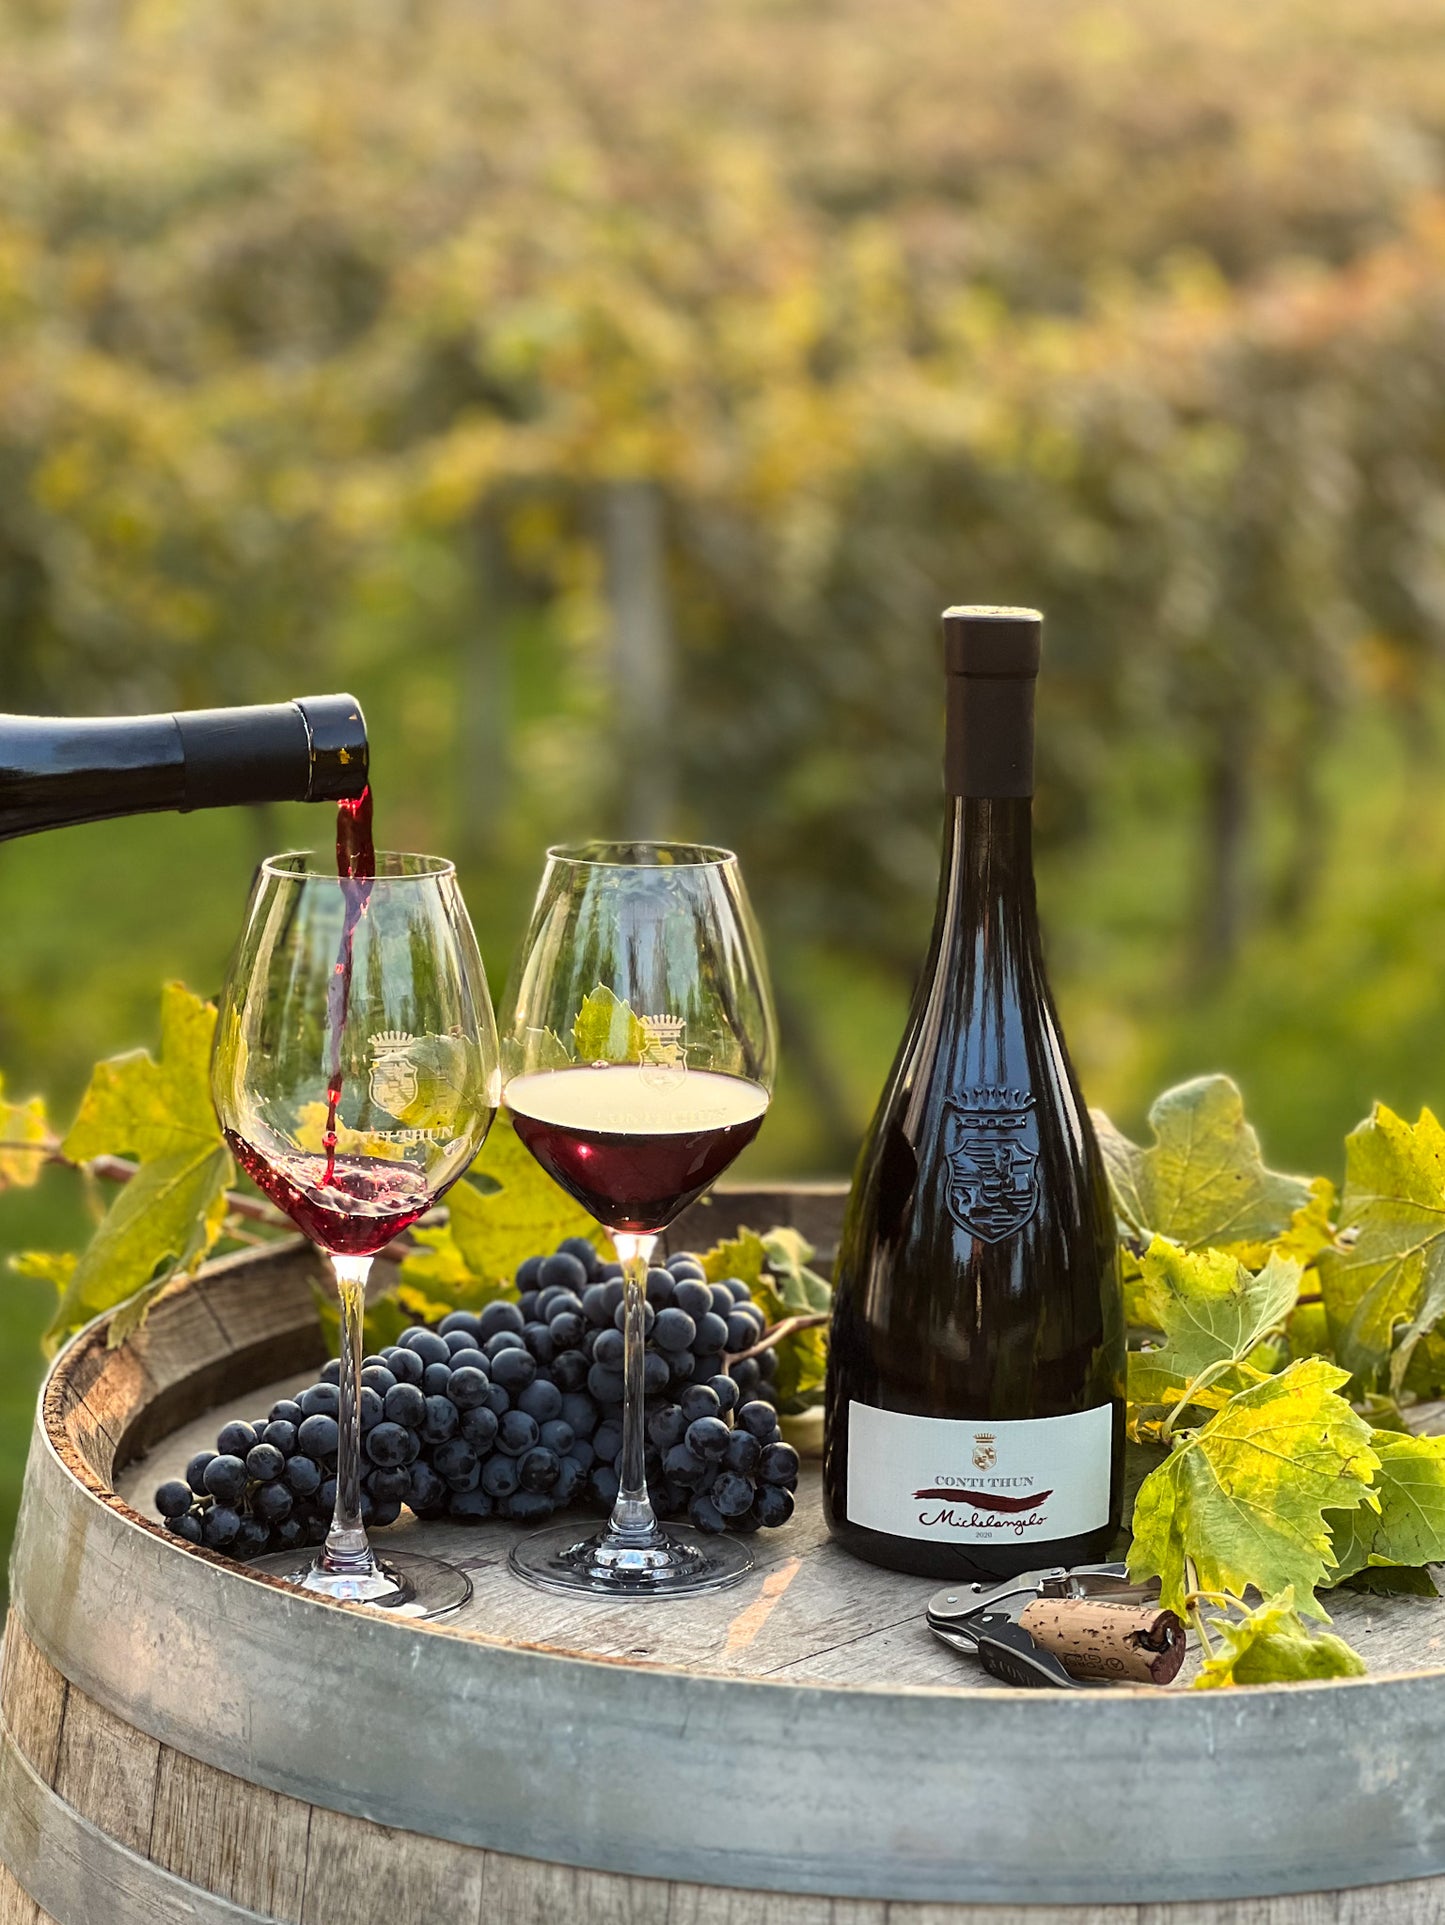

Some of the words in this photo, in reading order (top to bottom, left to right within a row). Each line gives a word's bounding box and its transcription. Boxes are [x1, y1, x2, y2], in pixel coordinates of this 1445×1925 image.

[935, 1475, 985, 1487] CONTI
[988, 1476, 1034, 1487] THUN
[919, 1508, 1048, 1536] Michelangelo
